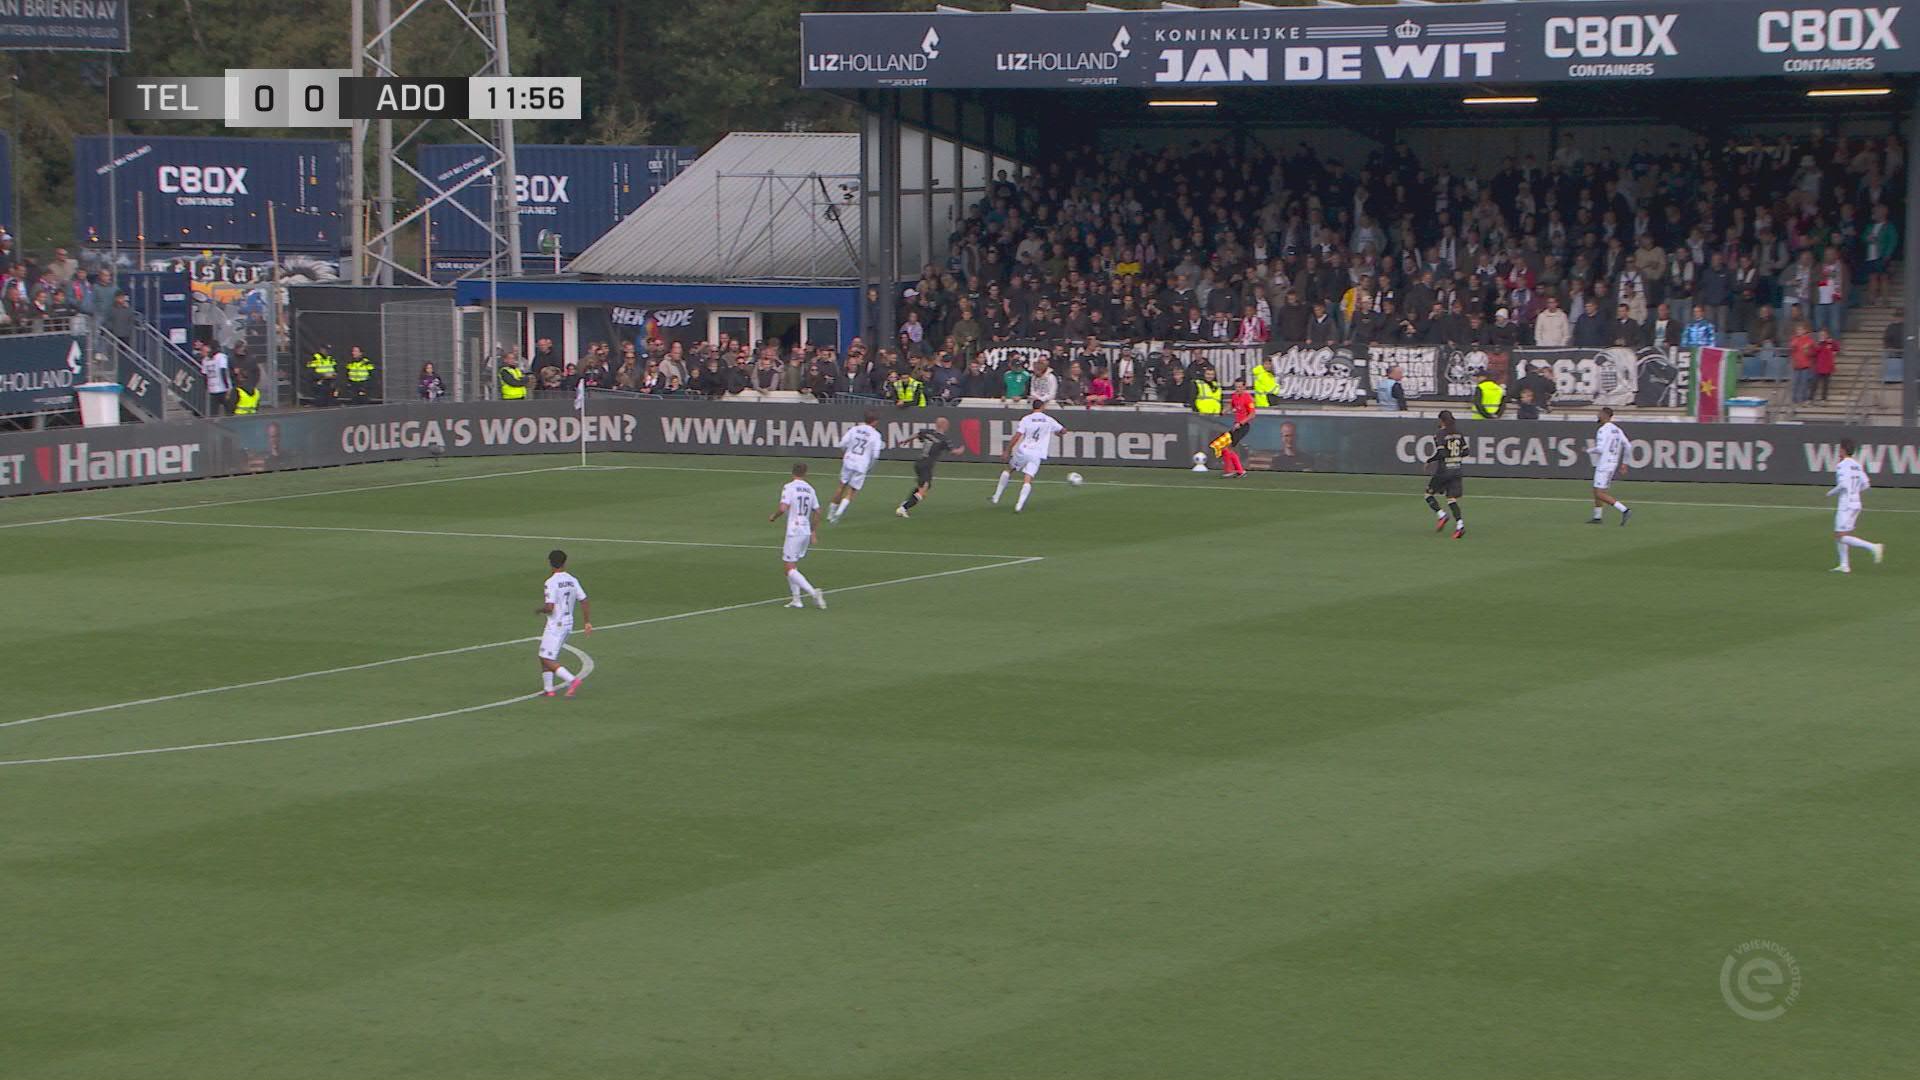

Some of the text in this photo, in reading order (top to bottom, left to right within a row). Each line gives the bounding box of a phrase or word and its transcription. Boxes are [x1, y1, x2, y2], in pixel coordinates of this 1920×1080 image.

[1154, 27, 1300, 41] KONINKLIJKE
[1544, 14, 1680, 58] CBOX
[1757, 6, 1901, 53] CBOX
[808, 53, 928, 72] LIZHOLLAND
[996, 52, 1119, 71] LIZHOLLAND
[1155, 42, 1506, 82] JAN DE WIT
[1568, 63, 1656, 77] CONTAINERS
[1783, 57, 1875, 72] CONTAINERS
[158, 165, 249, 195] CBOX
[513, 175, 570, 203] BOX
[176, 197, 235, 207] CONTAINERS
[653, 308, 694, 328] SIDE
[0, 369, 73, 393] HOLLAND
[342, 414, 637, 453] COLLEGA'S WORDEN?
[989, 420, 1178, 461] Hmer
[1031, 426, 1040, 443] 4
[851, 437, 867, 456] 23
[59, 442, 200, 484] Hamer
